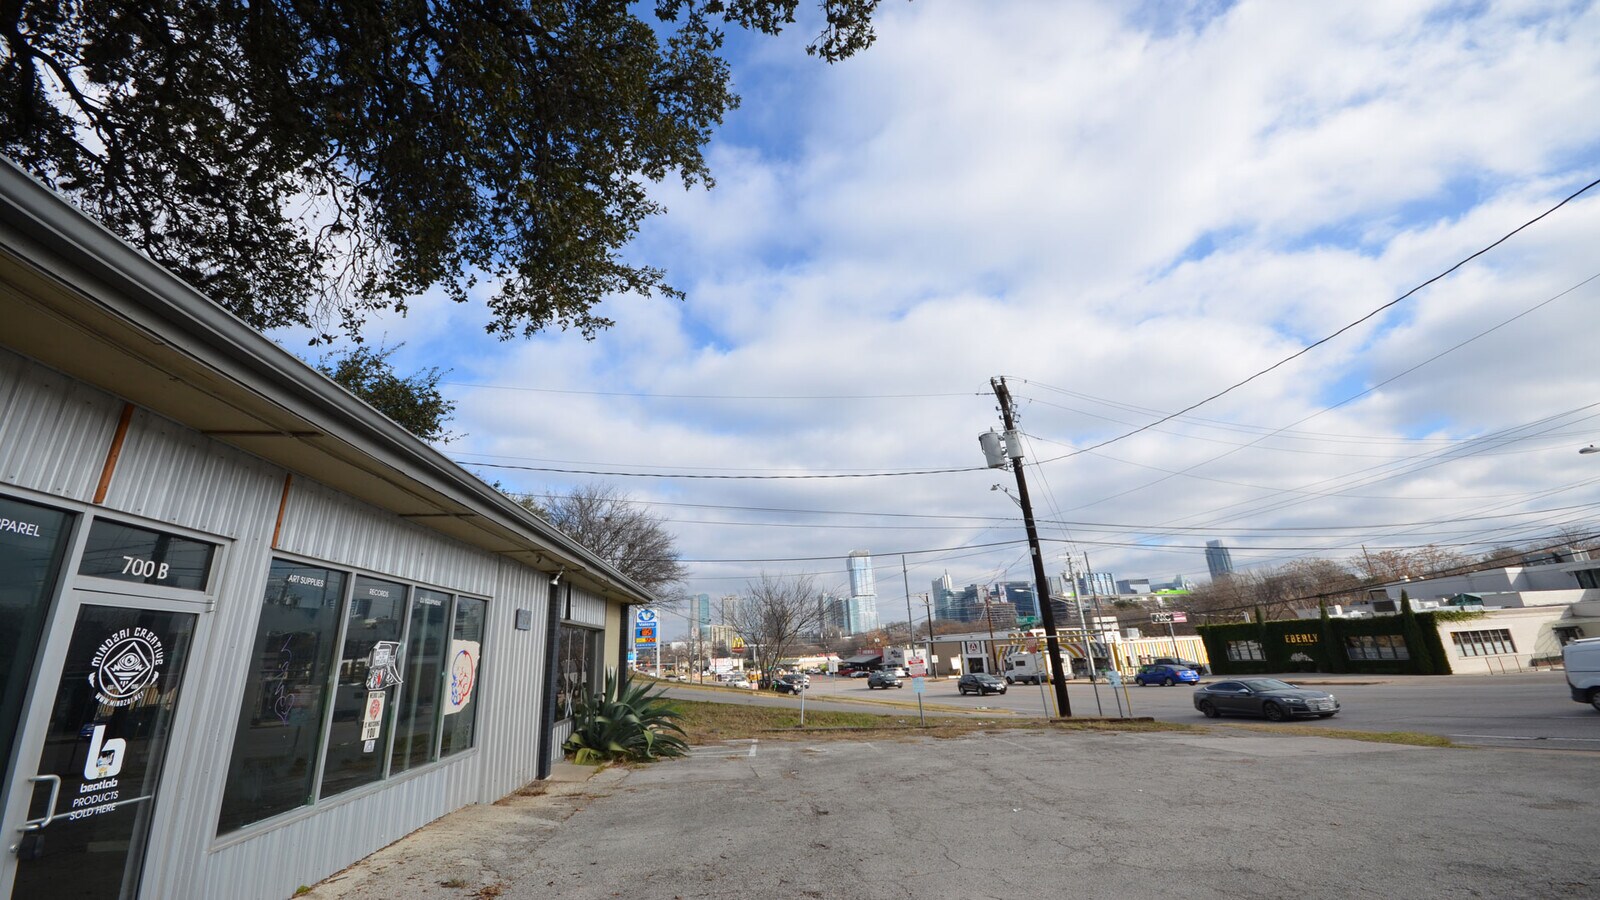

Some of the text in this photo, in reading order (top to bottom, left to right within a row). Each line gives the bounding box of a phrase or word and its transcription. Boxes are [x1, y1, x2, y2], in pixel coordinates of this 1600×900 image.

[0, 518, 40, 537] PAREL
[121, 555, 169, 580] 700 B
[288, 574, 324, 588] ART SUPPLIES
[368, 588, 390, 598] RECORDS
[1284, 633, 1318, 643] EBERLY
[134, 627, 163, 666] CREATIVE
[80, 778, 118, 793] beatlab
[72, 791, 119, 807] PRODUCTS
[70, 803, 117, 820] SOLD HERE
